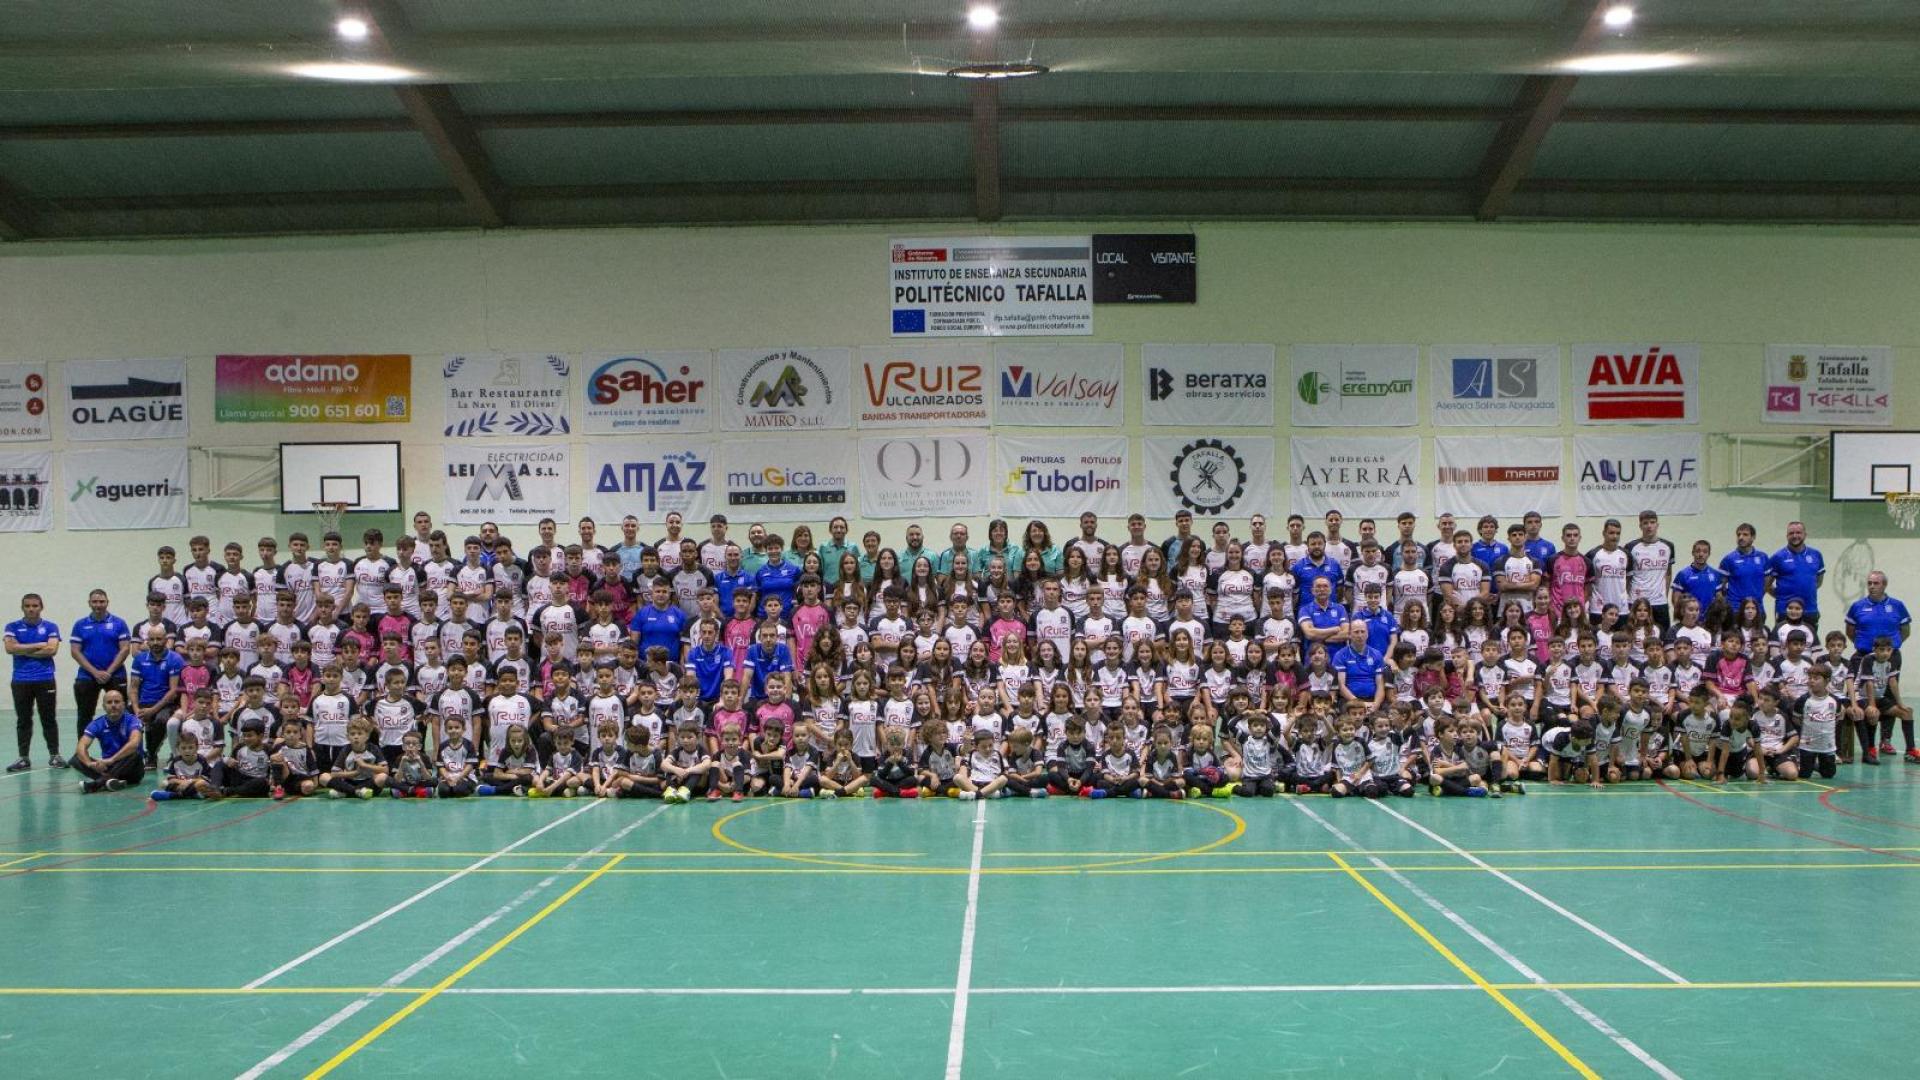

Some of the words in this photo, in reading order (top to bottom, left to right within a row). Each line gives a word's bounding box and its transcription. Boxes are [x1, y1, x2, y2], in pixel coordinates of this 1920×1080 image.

[1097, 252, 1128, 264] LOCAL
[1151, 252, 1197, 264] VISITANTE
[895, 269, 947, 281] INSTITUTO
[950, 269, 962, 280] DE
[1024, 267, 1087, 279] SECUNDARIA
[895, 281, 1005, 304] POLITÉCNICO
[1016, 284, 1087, 302] TAFALLA
[265, 359, 359, 384] adamo
[1817, 361, 1869, 375] Tafalla
[451, 388, 473, 398] Bar
[480, 388, 561, 398] Restaurante
[1036, 371, 1119, 408] Valsay
[1186, 390, 1213, 398] obras
[1216, 391, 1222, 399] y
[1224, 390, 1266, 398] servicios
[1807, 392, 1888, 407] TAFALLA
[72, 401, 183, 424] OLAGÜE
[289, 405, 319, 418] 900
[325, 405, 350, 417] 651
[354, 404, 379, 417] 601
[862, 413, 897, 421] BANDAS
[898, 410, 986, 420] TRANSPORTADORAS
[488, 453, 564, 463] ELECTRICIDAD
[1020, 456, 1066, 464] PINTURAS
[1330, 455, 1385, 463] BODEGAS
[1300, 463, 1414, 485] AYERRA
[1581, 458, 1697, 483] ALUTAF
[96, 478, 169, 501] aguerri
